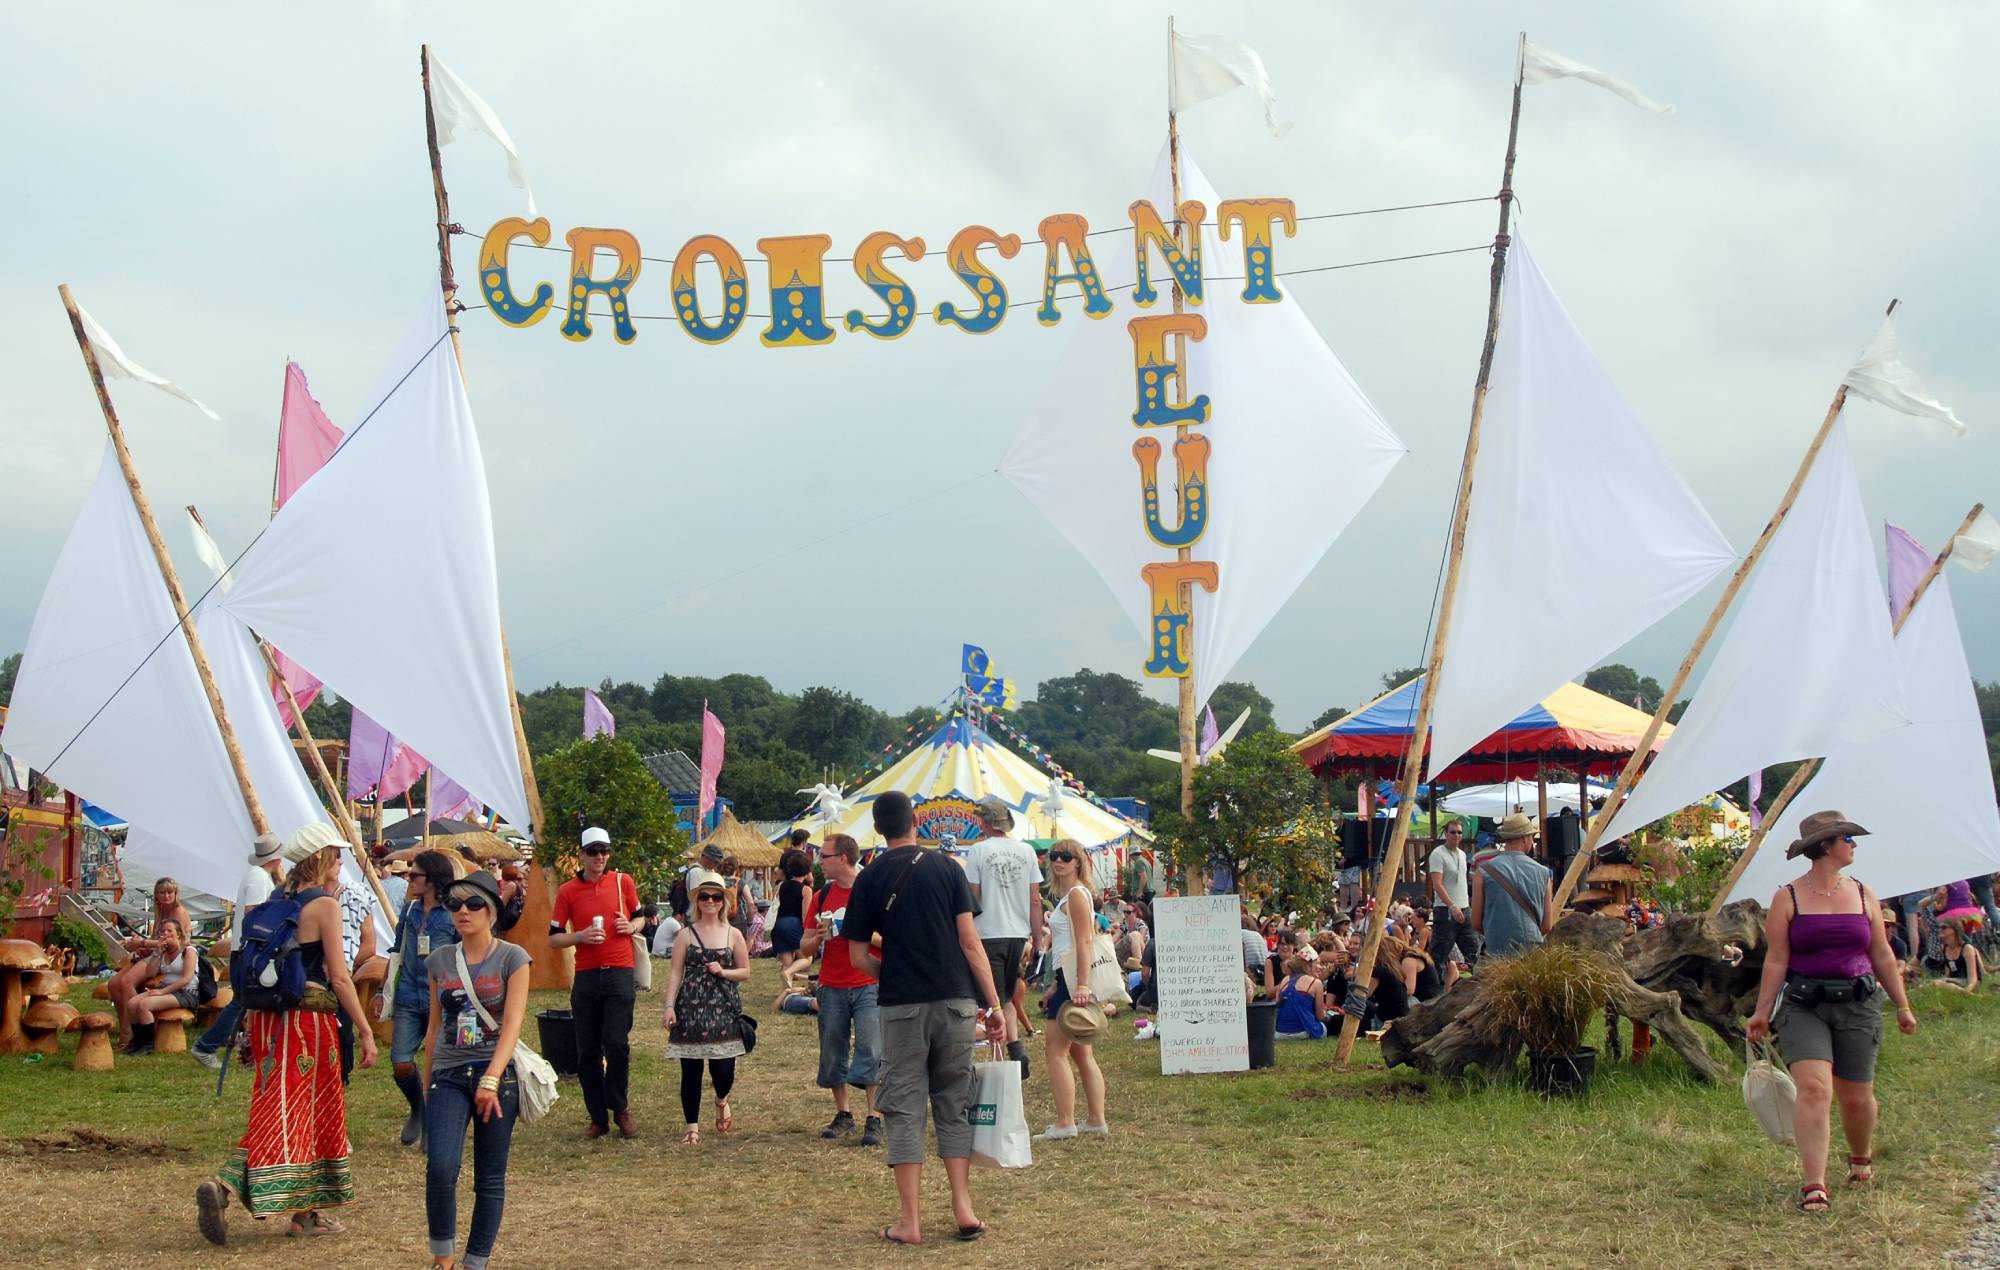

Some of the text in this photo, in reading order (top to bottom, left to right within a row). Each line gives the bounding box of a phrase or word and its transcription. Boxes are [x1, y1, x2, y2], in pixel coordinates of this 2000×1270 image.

[478, 198, 1297, 348] CROISSANT
[912, 805, 984, 828] ROISSAN
[1184, 913, 1213, 928] NEUF
[1205, 1037, 1216, 1046] BY
